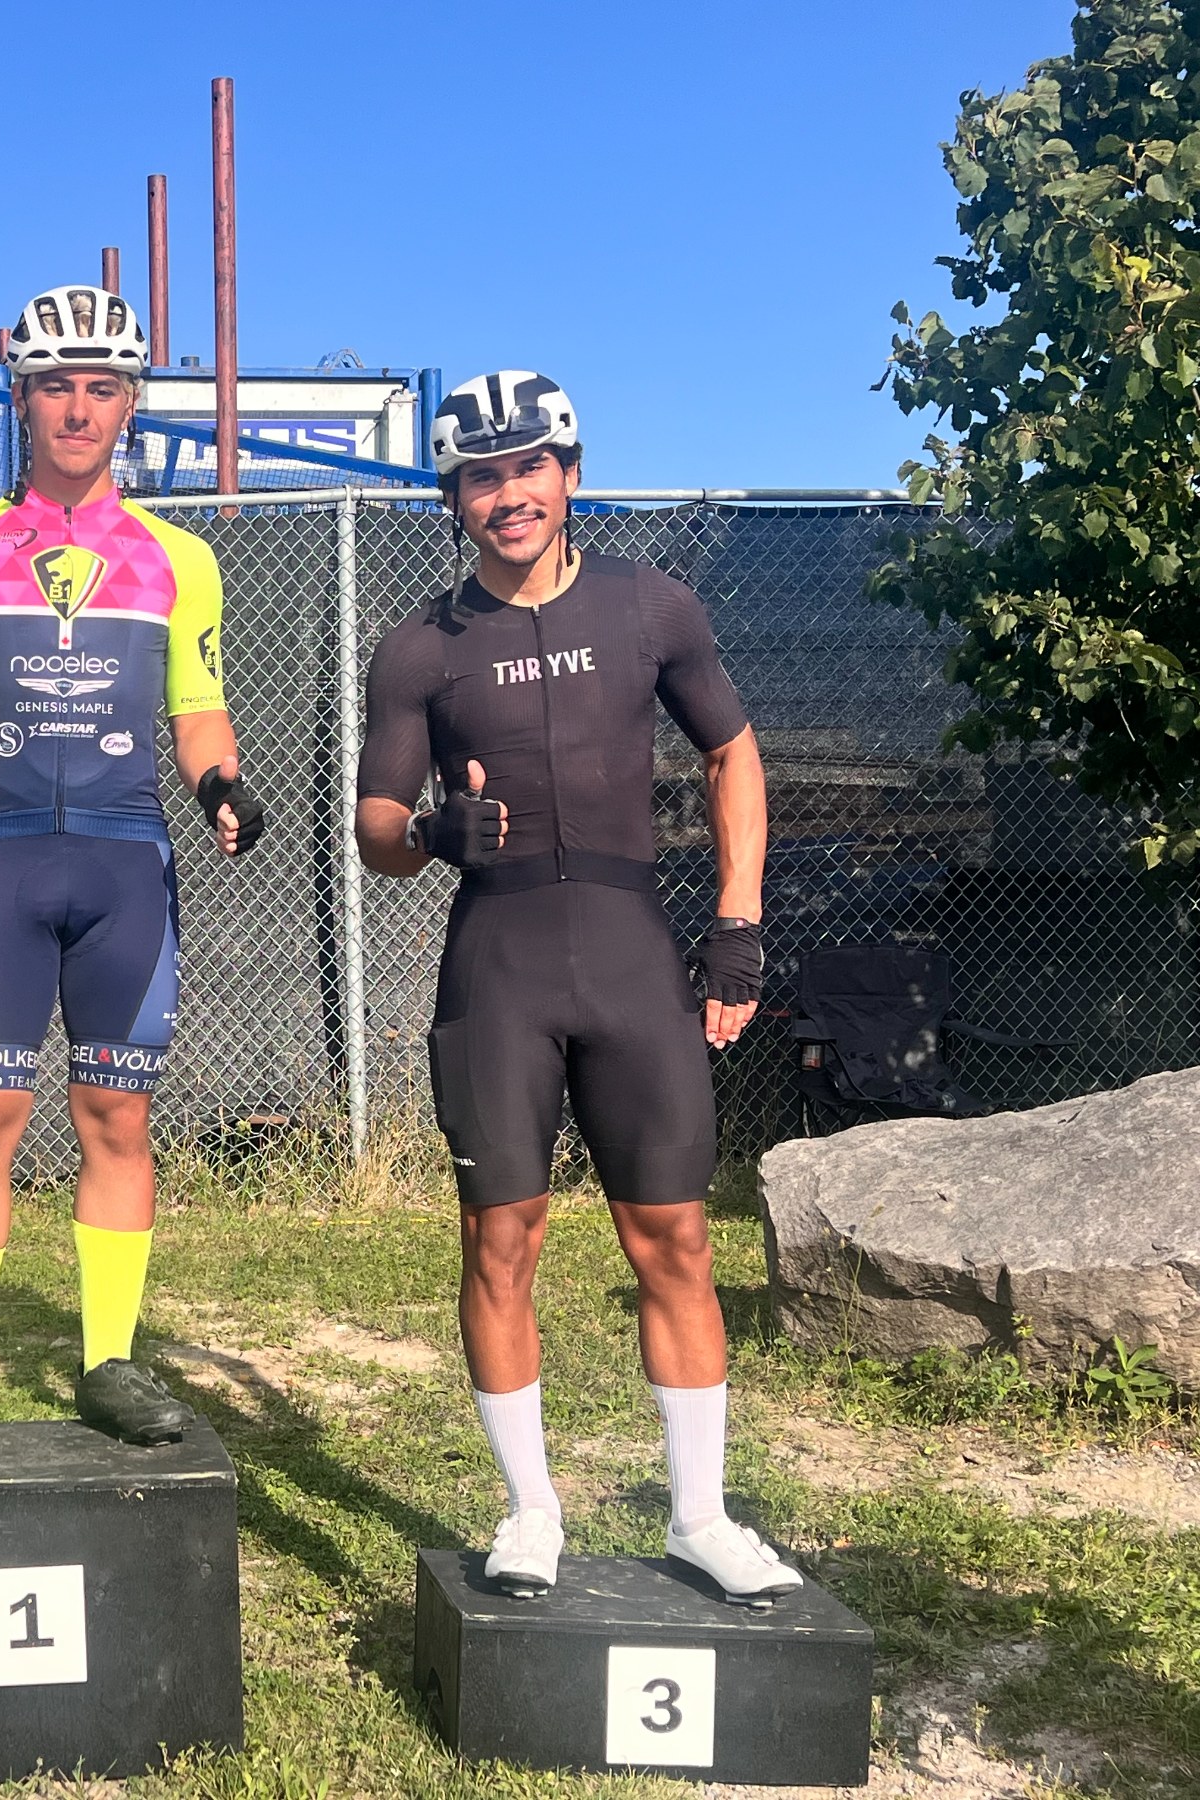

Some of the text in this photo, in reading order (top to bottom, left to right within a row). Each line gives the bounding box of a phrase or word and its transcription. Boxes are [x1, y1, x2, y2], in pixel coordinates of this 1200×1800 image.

[10, 652, 119, 675] nooelec
[492, 647, 596, 685] THRYVE
[15, 701, 113, 715] GENESIS MAPLE
[78, 1071, 139, 1090] MATTEO
[9, 1593, 55, 1649] 1
[640, 1678, 683, 1734] 3
